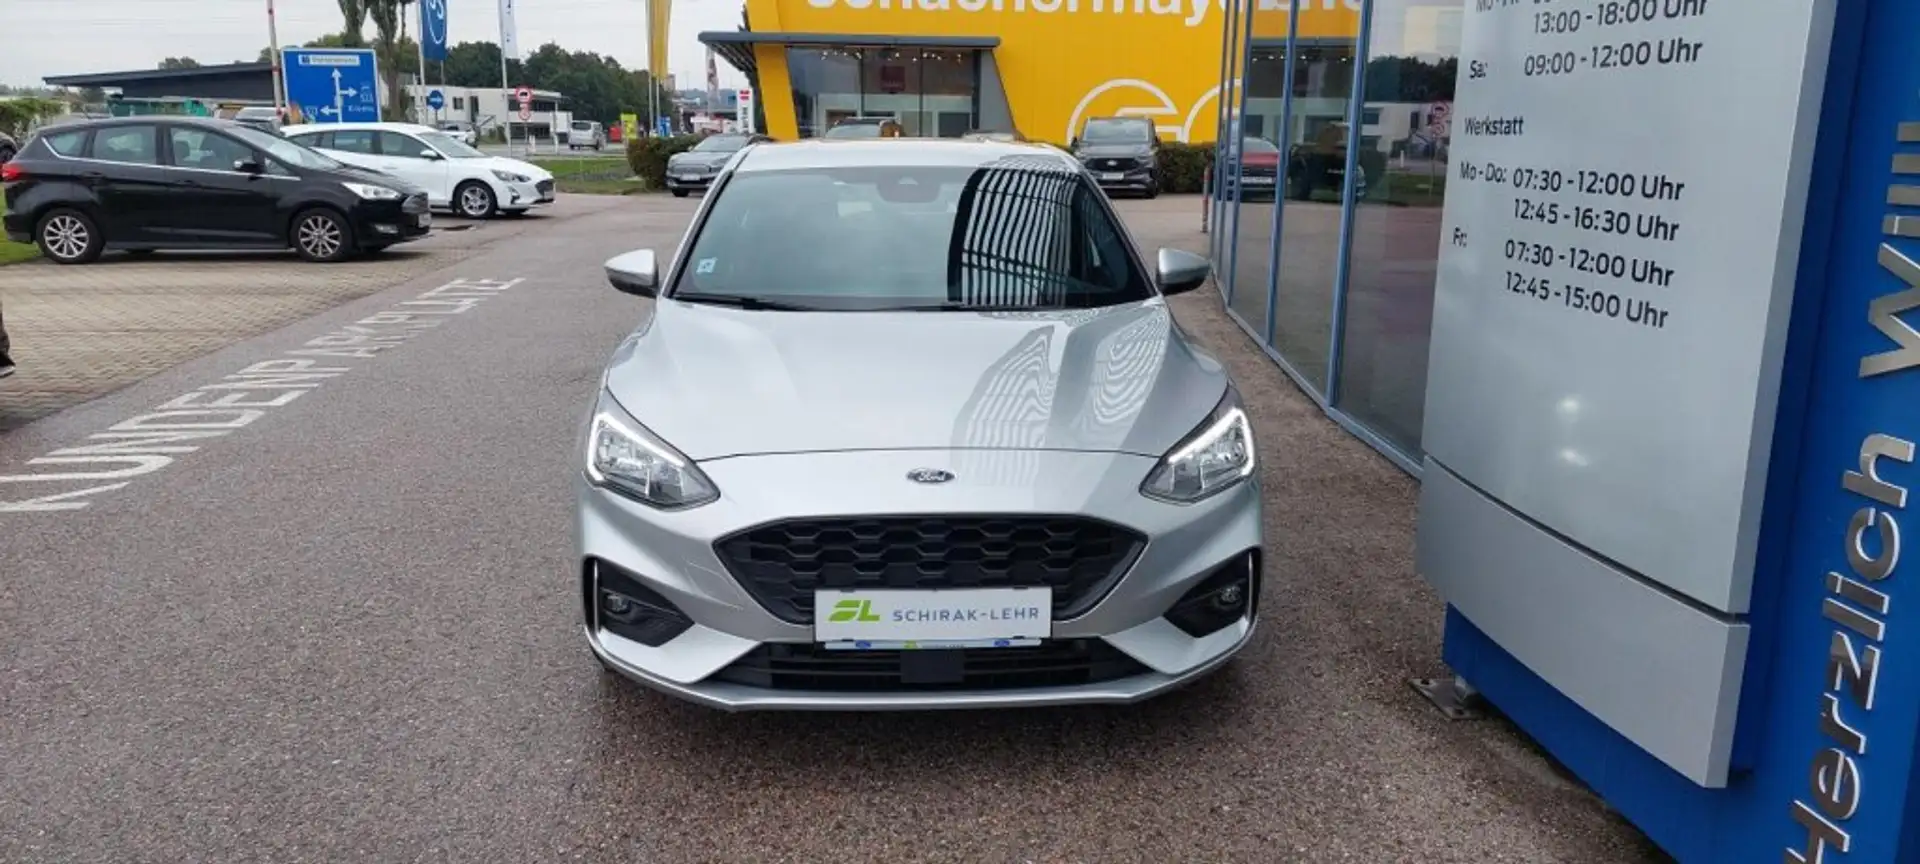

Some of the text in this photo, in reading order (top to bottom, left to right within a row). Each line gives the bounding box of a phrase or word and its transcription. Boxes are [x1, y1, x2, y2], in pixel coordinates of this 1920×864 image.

[1534, 10, 1581, 34] 13:00
[1597, 0, 1657, 26] 18:00
[1663, 0, 1706, 18] Uhr
[1524, 51, 1576, 77] 09:00
[1591, 41, 1651, 69] 12:00
[1656, 37, 1703, 65] Uhr
[1464, 116, 1524, 136] Werkstatt
[1513, 168, 1562, 193] 07:30
[1577, 170, 1635, 197] 12:00
[1641, 174, 1685, 201] Uhr
[1514, 198, 1559, 225] 12:45
[1574, 205, 1631, 235] 16:30
[1636, 214, 1680, 241] Uhr
[1505, 239, 1554, 267] 07:30
[1569, 247, 1625, 279] 12:00
[1631, 258, 1675, 287] Uhr
[1506, 271, 1550, 301] 12:45
[1564, 285, 1621, 318] 15:00
[1626, 298, 1669, 329] Uhr
[892, 606, 1040, 623] SCHIRAK-LEHR
[1783, 432, 1917, 864] Herzlich
